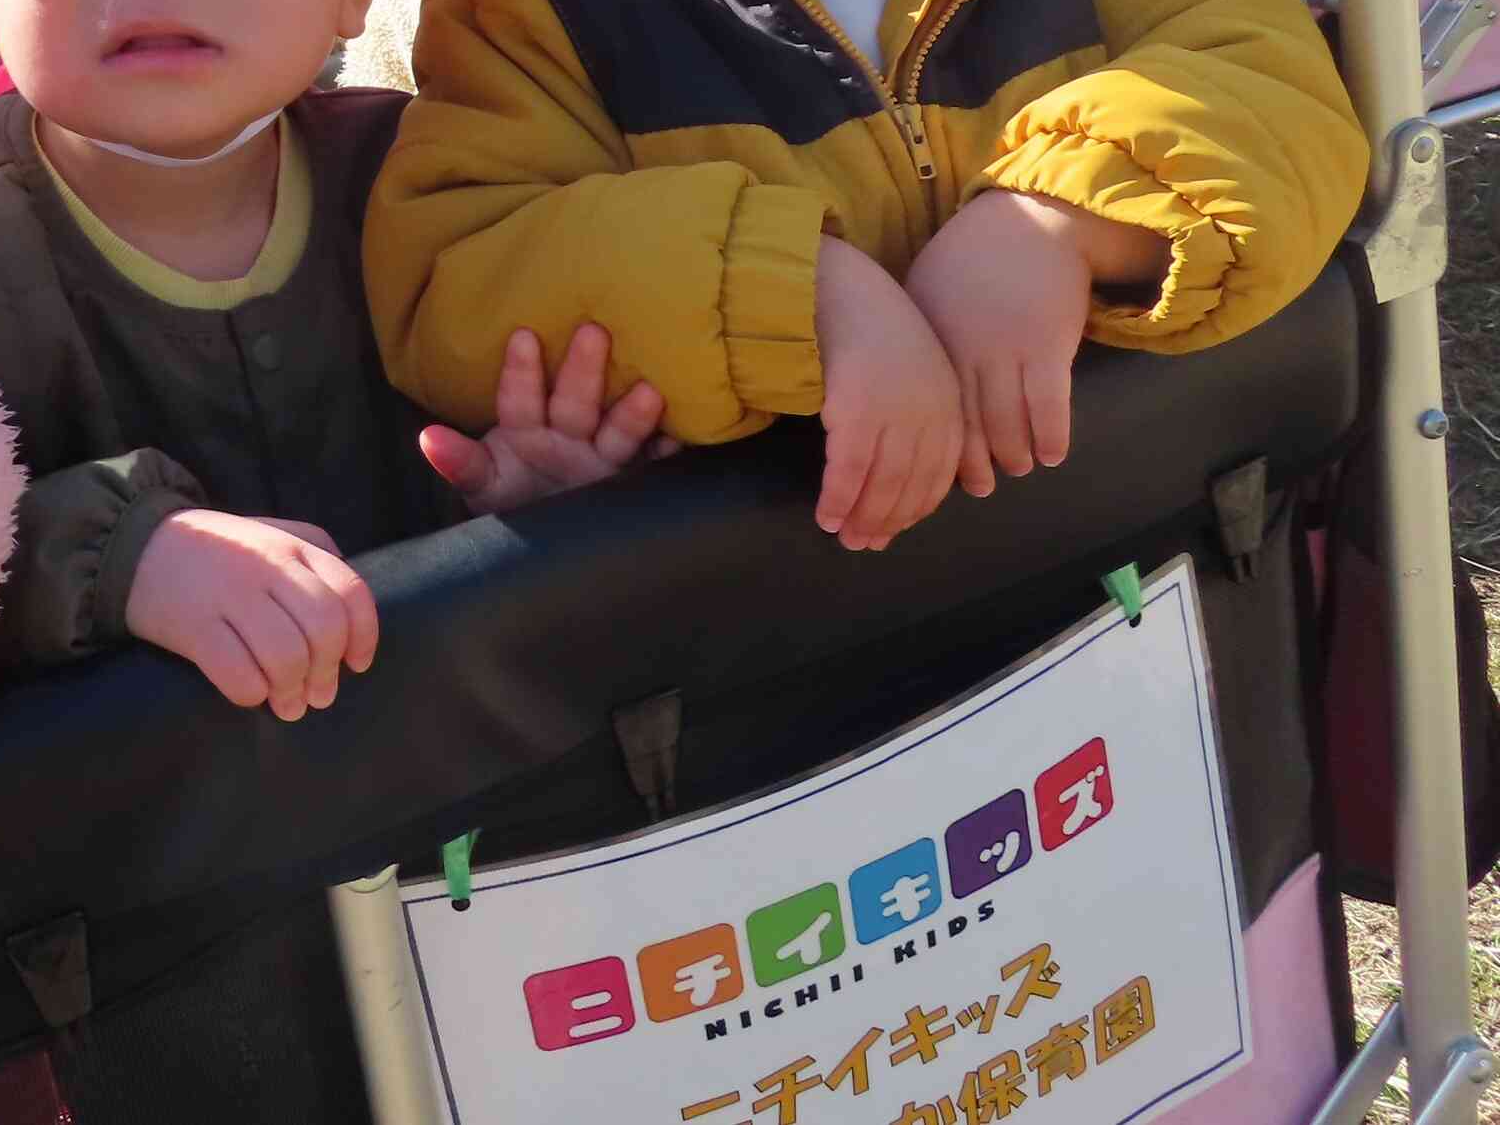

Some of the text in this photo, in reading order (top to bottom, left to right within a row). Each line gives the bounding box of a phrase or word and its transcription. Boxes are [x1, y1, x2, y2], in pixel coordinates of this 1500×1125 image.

[550, 750, 1111, 1045] ニチイキッズ
[704, 898, 997, 1041] NICHII KIDS
